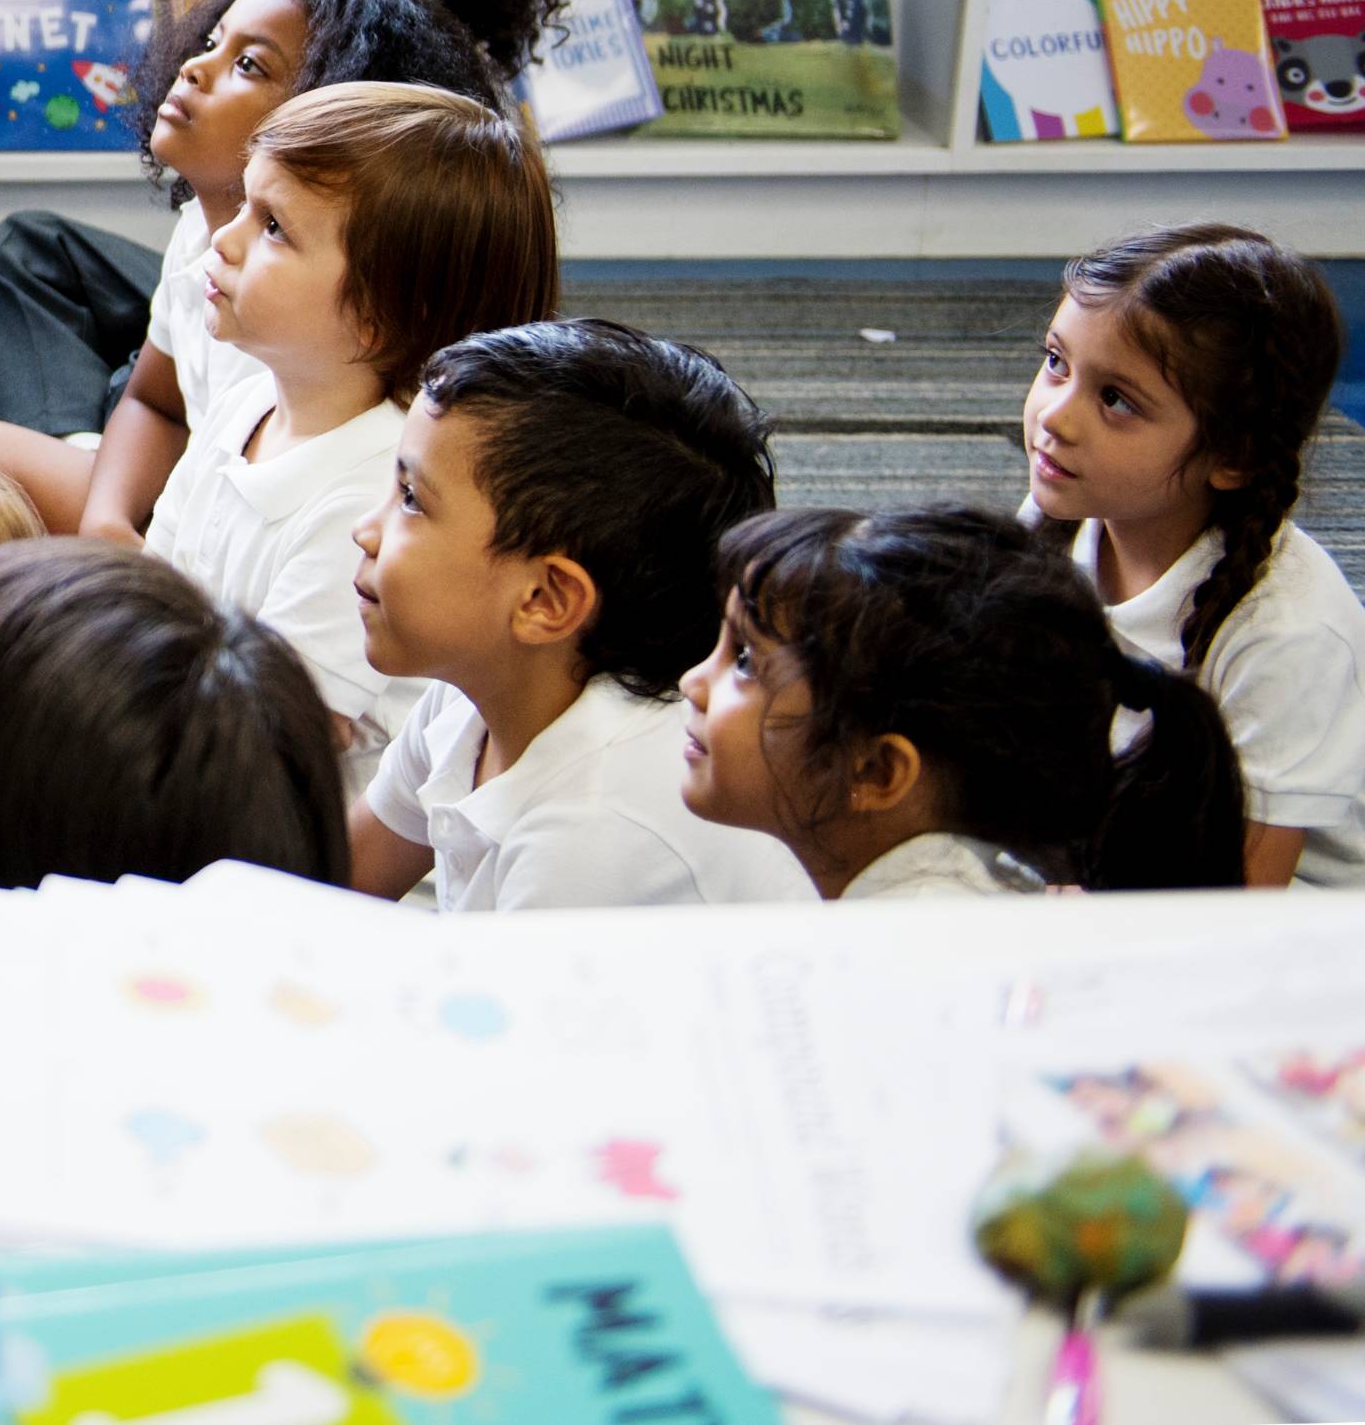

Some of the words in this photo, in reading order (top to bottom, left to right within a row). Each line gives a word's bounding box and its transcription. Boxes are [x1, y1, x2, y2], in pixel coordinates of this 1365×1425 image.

[658, 43, 735, 70] NIGHT
[991, 31, 1101, 60] COLORFU
[1125, 26, 1207, 60] HIPPO
[665, 85, 805, 117] CHRISTMAS
[539, 1276, 729, 1425] MAT
